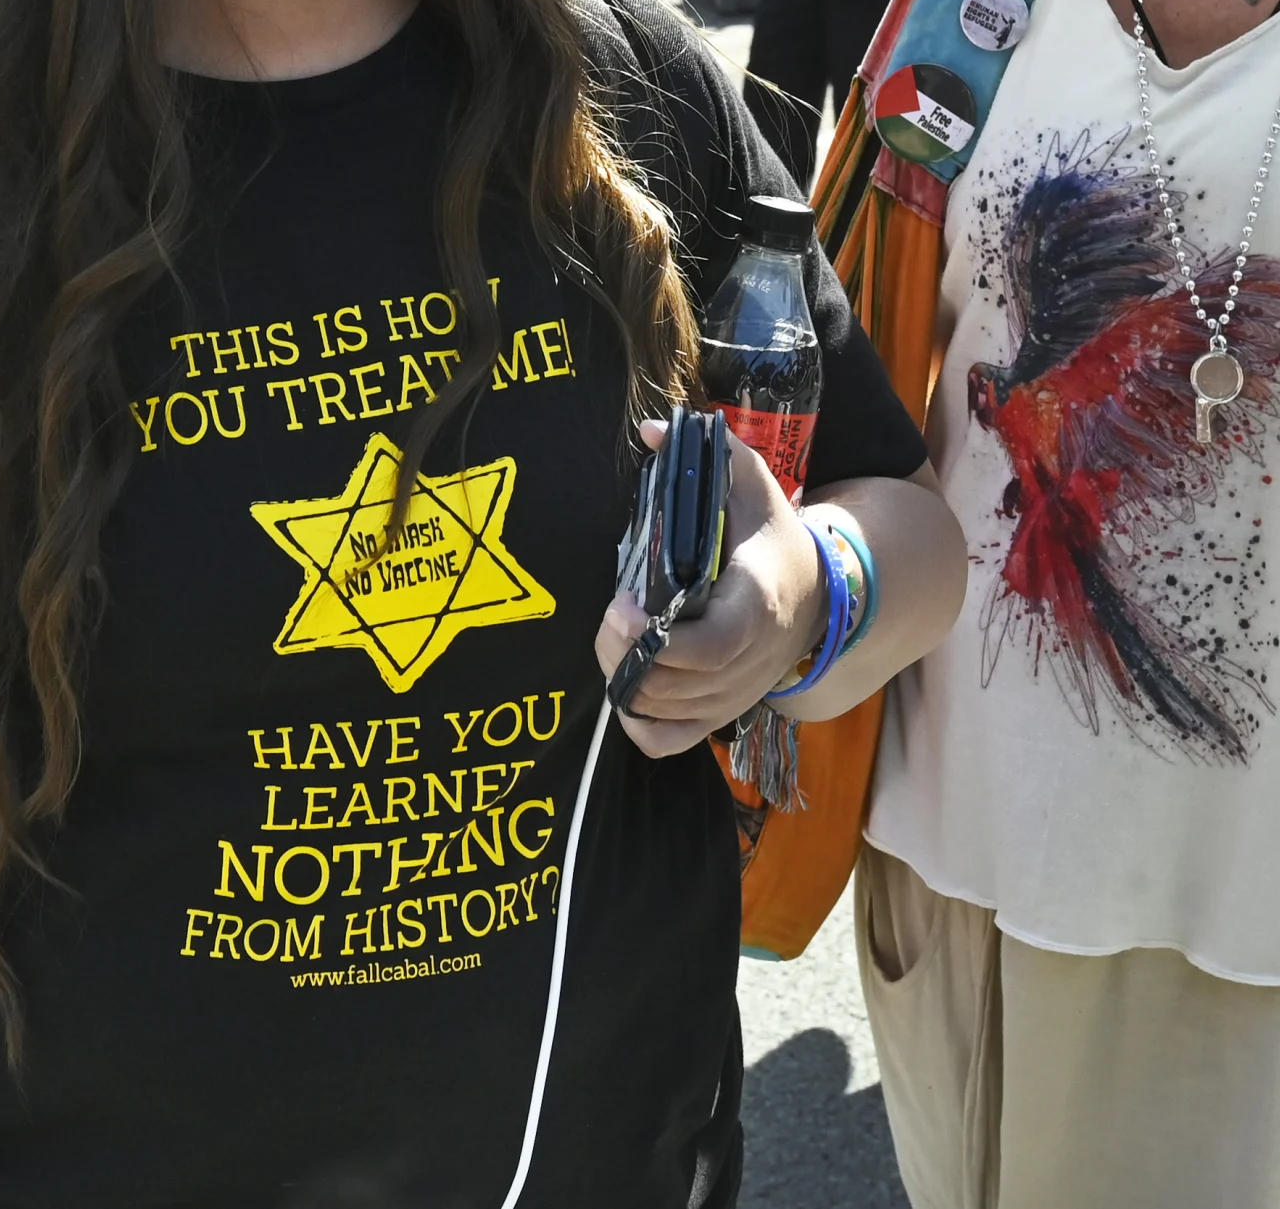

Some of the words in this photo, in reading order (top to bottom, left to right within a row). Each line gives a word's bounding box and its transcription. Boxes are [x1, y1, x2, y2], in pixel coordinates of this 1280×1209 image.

[963, 12, 998, 33] REFUGEES
[916, 114, 951, 142] Palestine
[929, 106, 953, 128] Free
[170, 321, 300, 378] THIS
[313, 304, 369, 358] IS
[129, 386, 247, 453] YOU
[267, 348, 462, 432] TREAT
[490, 317, 577, 392] ME!
[783, 419, 803, 478] AGAIN
[247, 716, 422, 770] HAVE
[443, 690, 566, 753] YOU
[213, 796, 556, 906] NOTHING
[179, 908, 325, 963] FROM
[339, 864, 560, 956] HISTORY?
[290, 951, 483, 989] www.fallcabal.com
